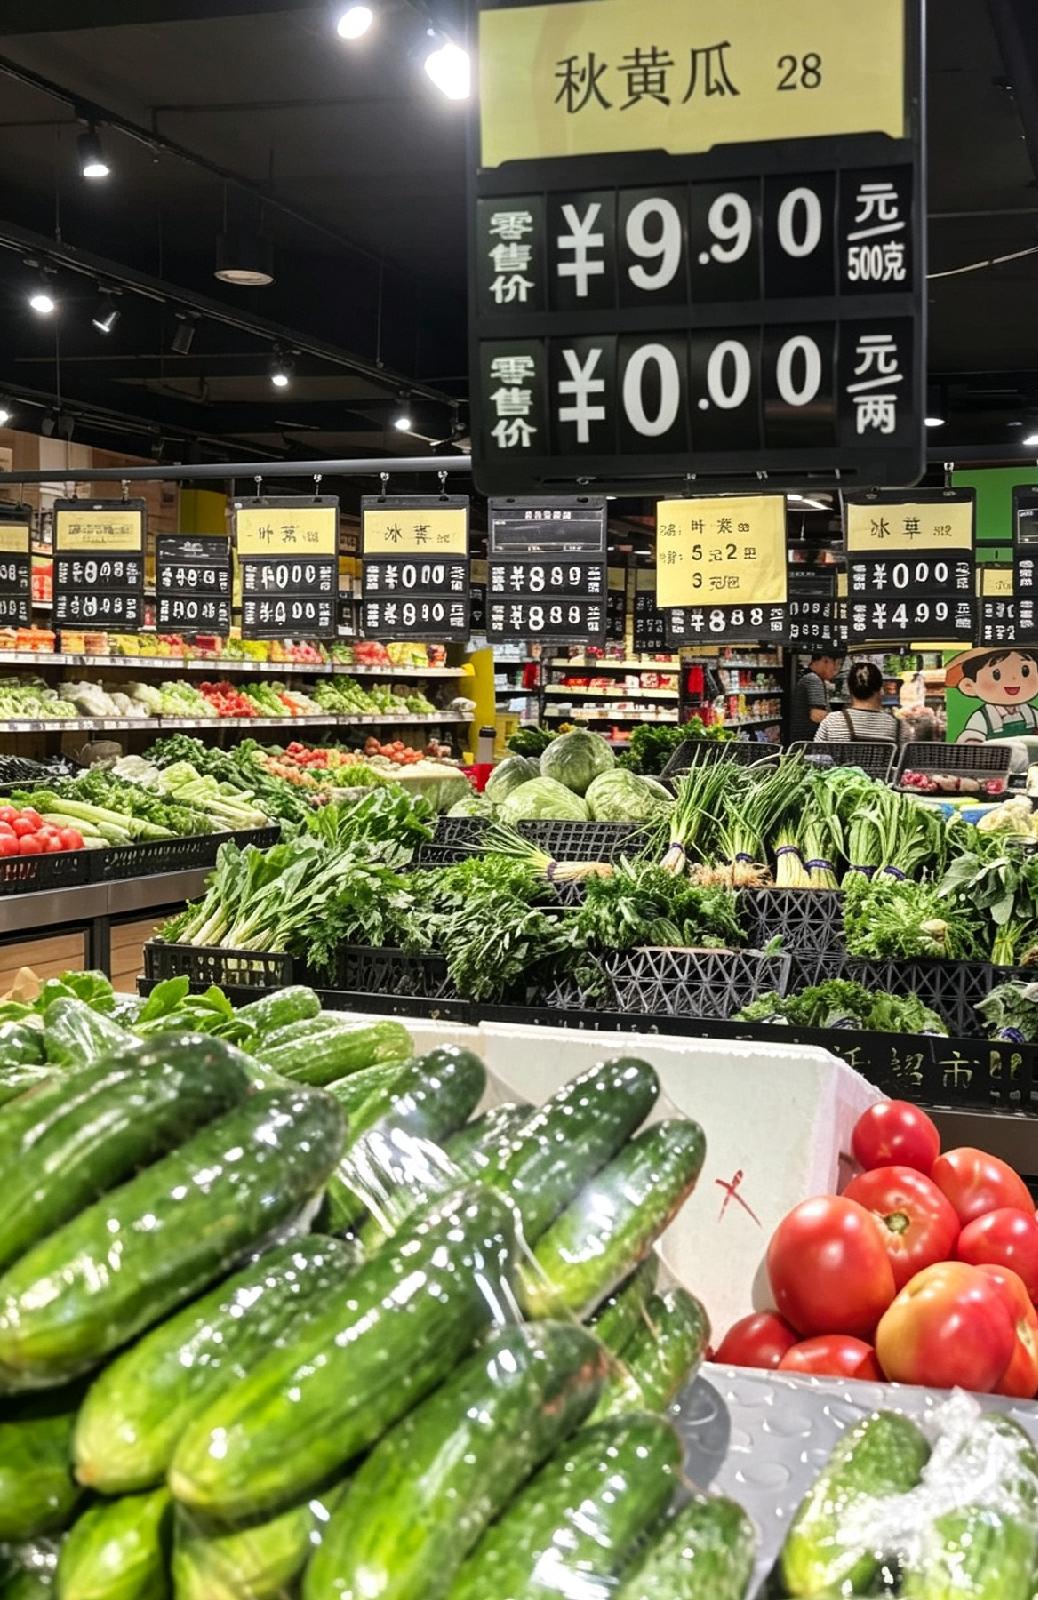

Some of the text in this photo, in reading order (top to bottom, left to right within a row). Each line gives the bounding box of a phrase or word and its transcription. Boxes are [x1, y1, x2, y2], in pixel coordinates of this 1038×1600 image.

[555, 40, 822, 113] 秋黄瓜 28
[489, 210, 535, 304] 零售价
[557, 188, 821, 297] ¥9.90
[490, 356, 537, 448] 零售价
[558, 335, 821, 443] ¥0.00
